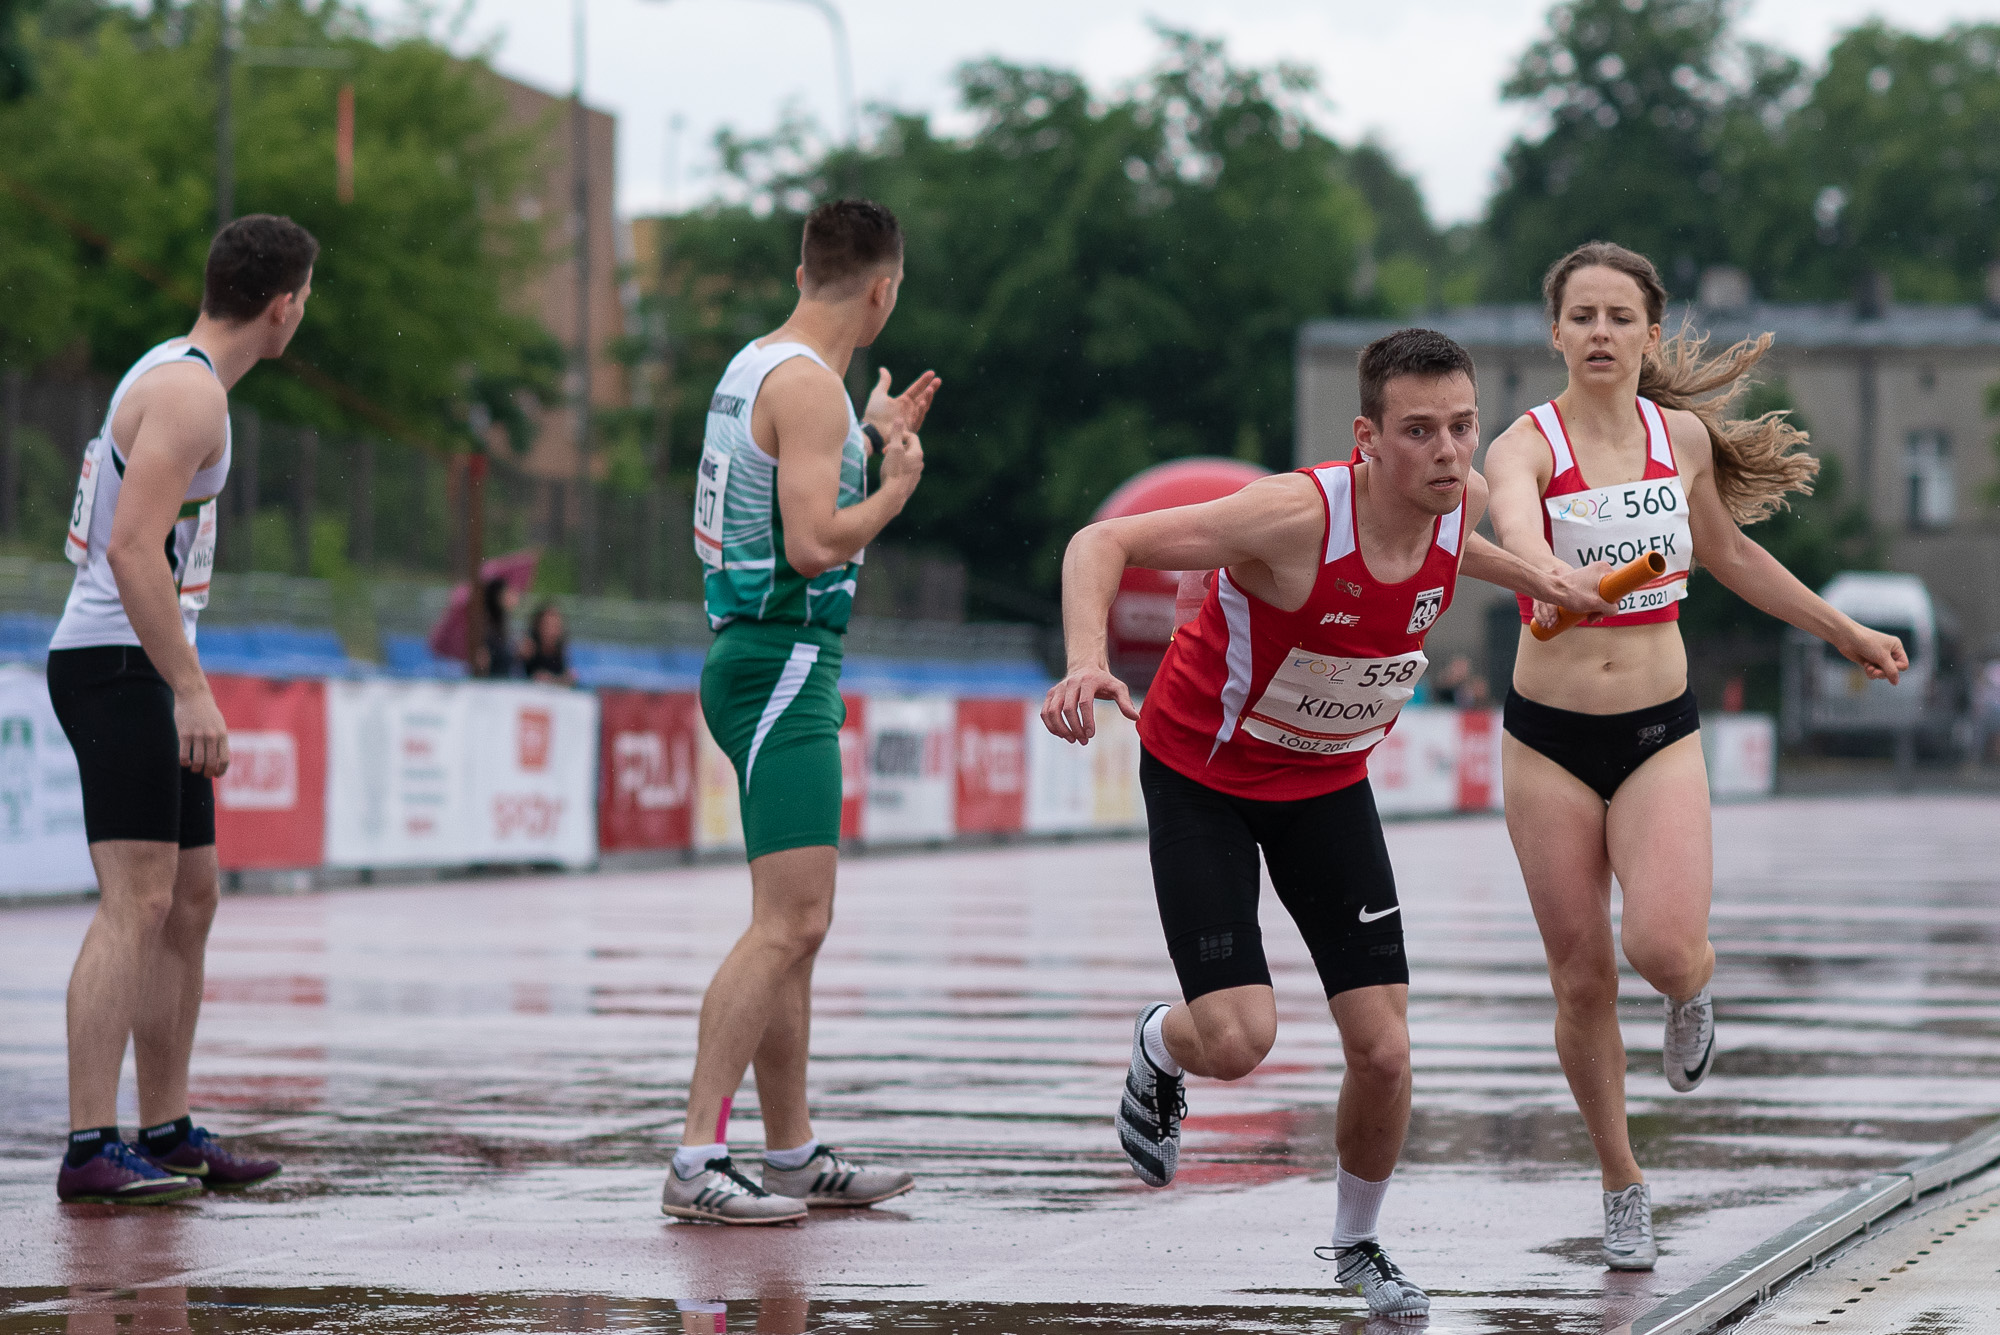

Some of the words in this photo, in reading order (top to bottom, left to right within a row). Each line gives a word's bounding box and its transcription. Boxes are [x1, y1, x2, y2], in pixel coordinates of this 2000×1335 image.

[1623, 486, 1677, 518] 560
[1576, 533, 1677, 567] WSOŁEK
[1618, 593, 1636, 611] DŹ
[1639, 590, 1668, 608] 2021
[1358, 660, 1418, 687] 558
[1296, 695, 1384, 720] KIDOŃ
[1278, 734, 1321, 750] ŁÓDŹ
[1321, 740, 1353, 753] 2021
